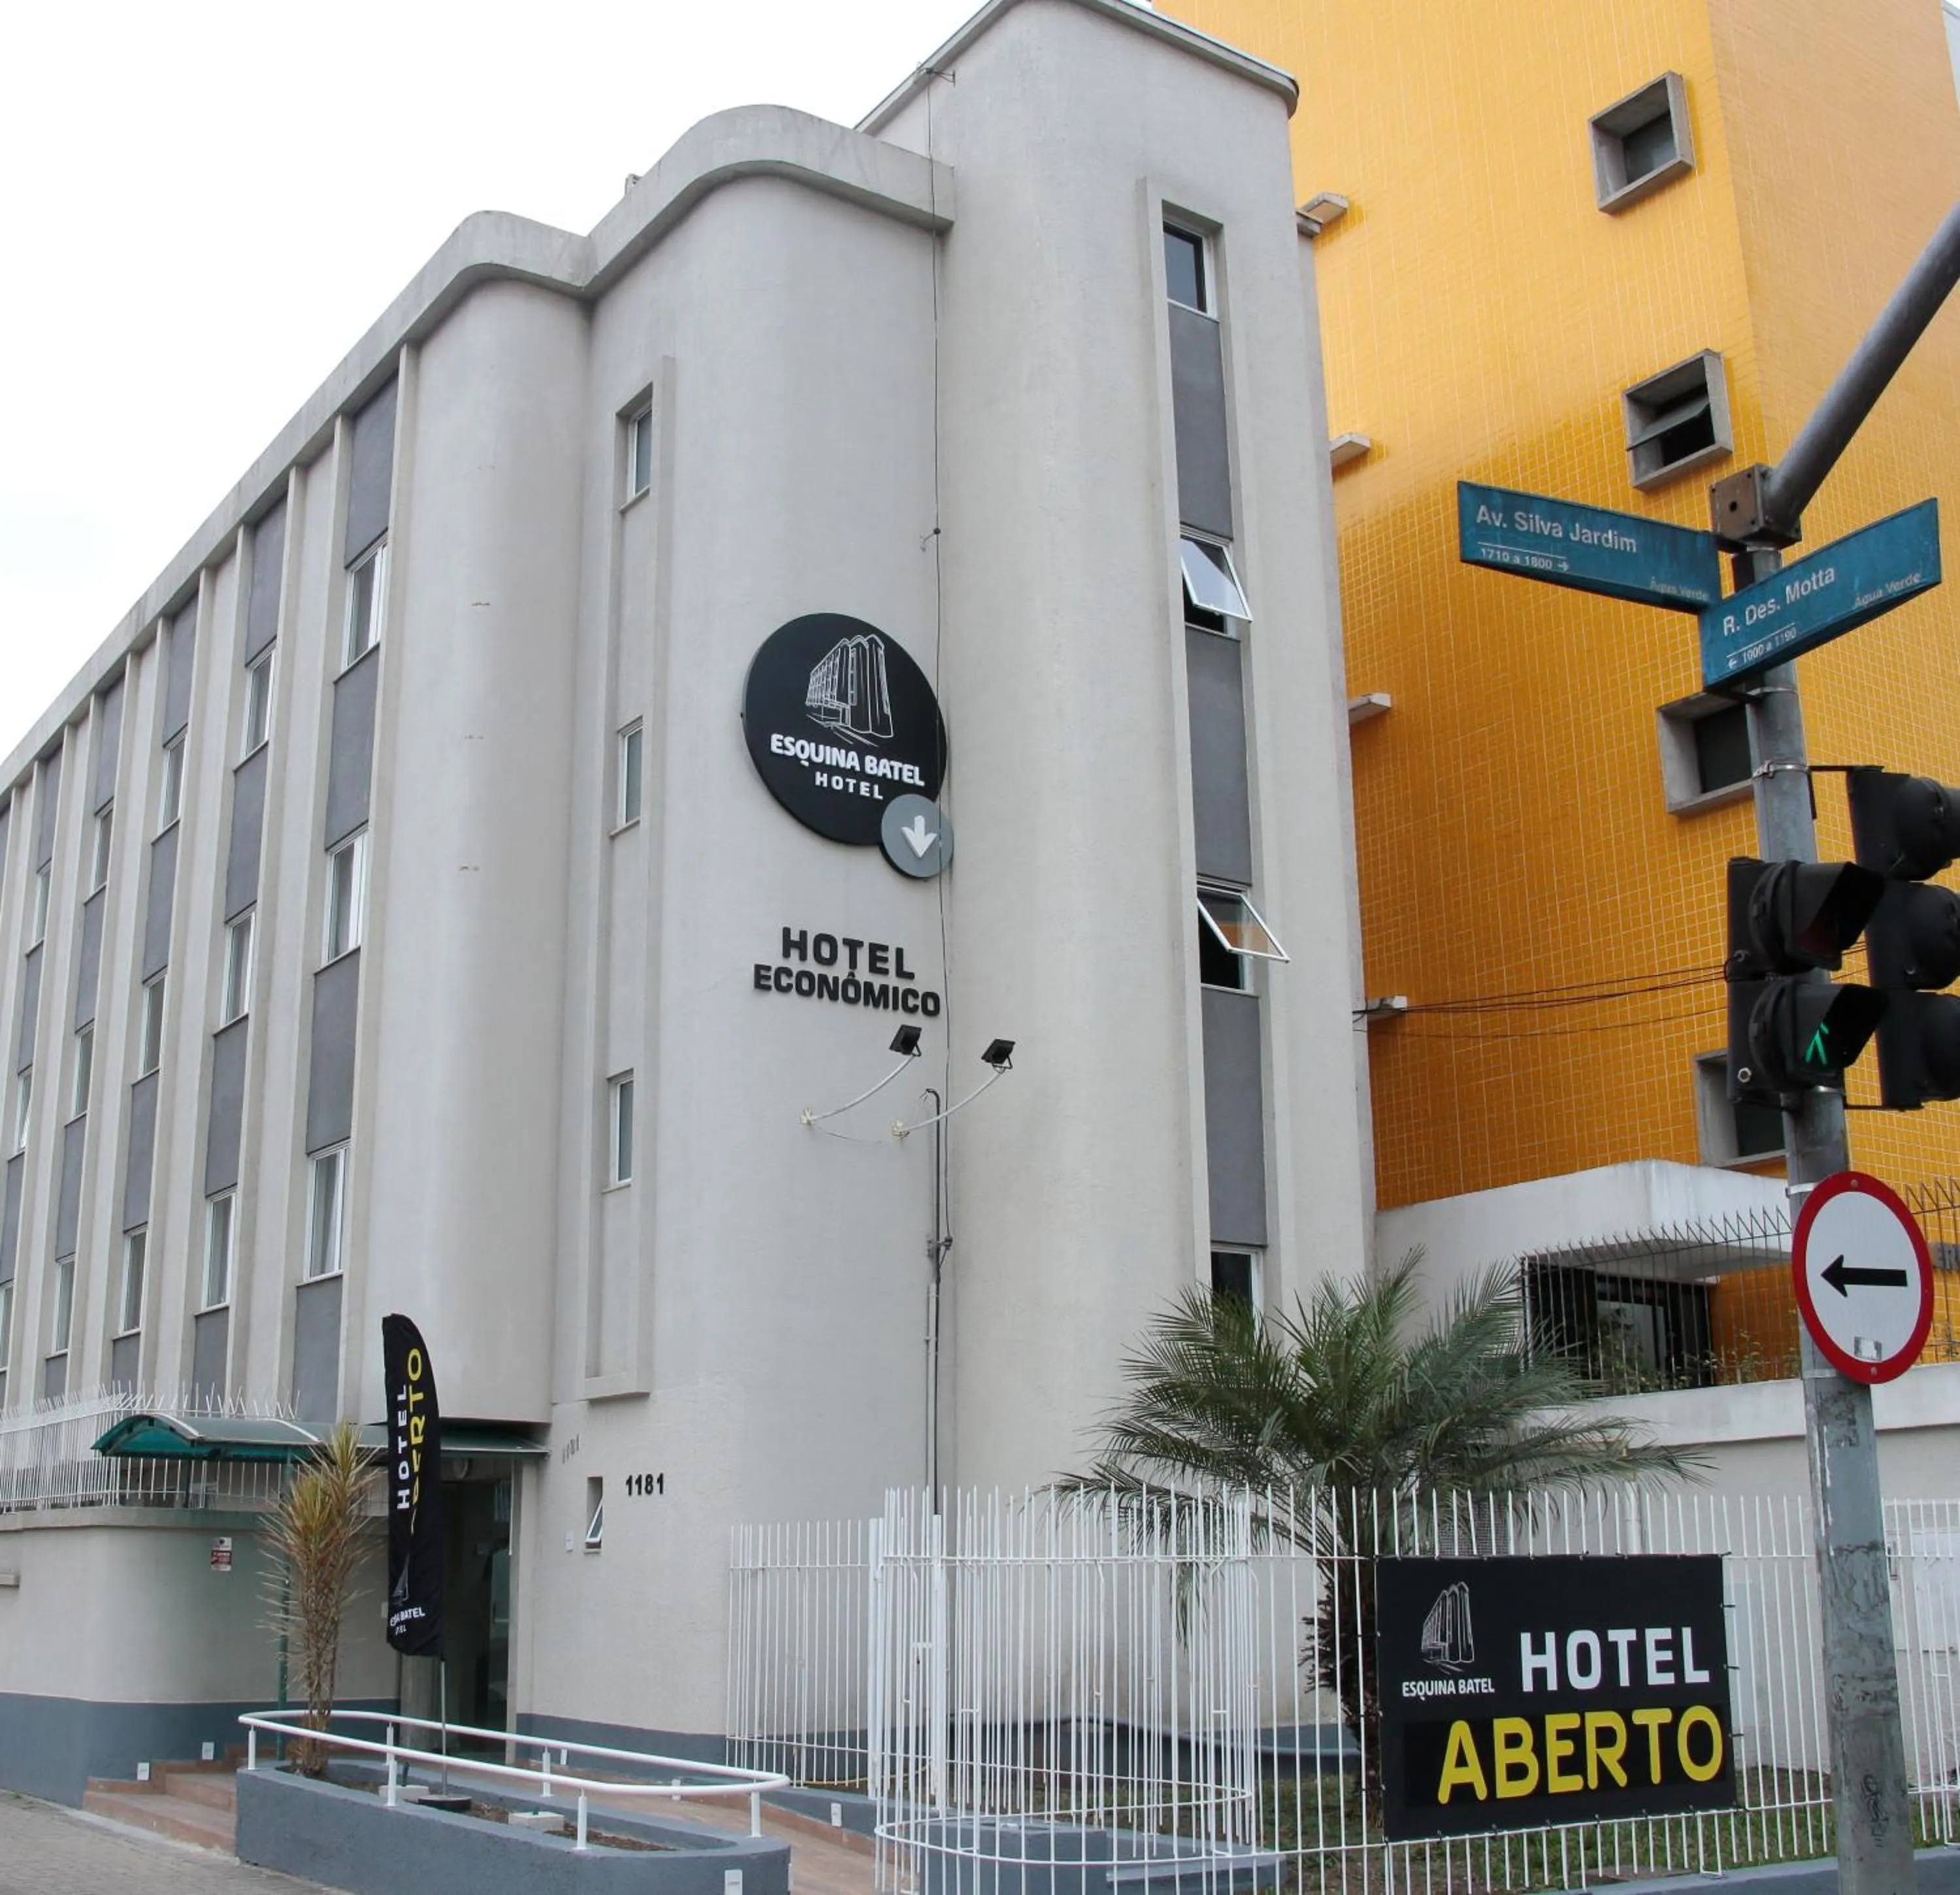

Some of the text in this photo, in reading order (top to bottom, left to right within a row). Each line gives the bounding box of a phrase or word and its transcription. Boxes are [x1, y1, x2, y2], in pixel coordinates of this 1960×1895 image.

[1477, 505, 1637, 552] Av. Silva Jardim
[1480, 548, 1552, 569] 1710 a 1800
[1723, 567, 1835, 636] R. Des. Motta
[1743, 644, 1764, 664] 1000
[1765, 642, 1772, 653] a
[770, 733, 925, 787] ESQUINA BATEL
[815, 771, 883, 800] HOTEL
[782, 926, 915, 980] HOTEL
[753, 963, 941, 1017] ECONÔMICO
[397, 1385, 410, 1509] HOTEL
[408, 1348, 425, 1535] ERTO
[625, 1472, 664, 1496] 1181
[1520, 1626, 1710, 1692] HOTEL
[1402, 1677, 1495, 1701] ESQUINA BATEL
[1437, 1705, 1723, 1805] ABERTO
